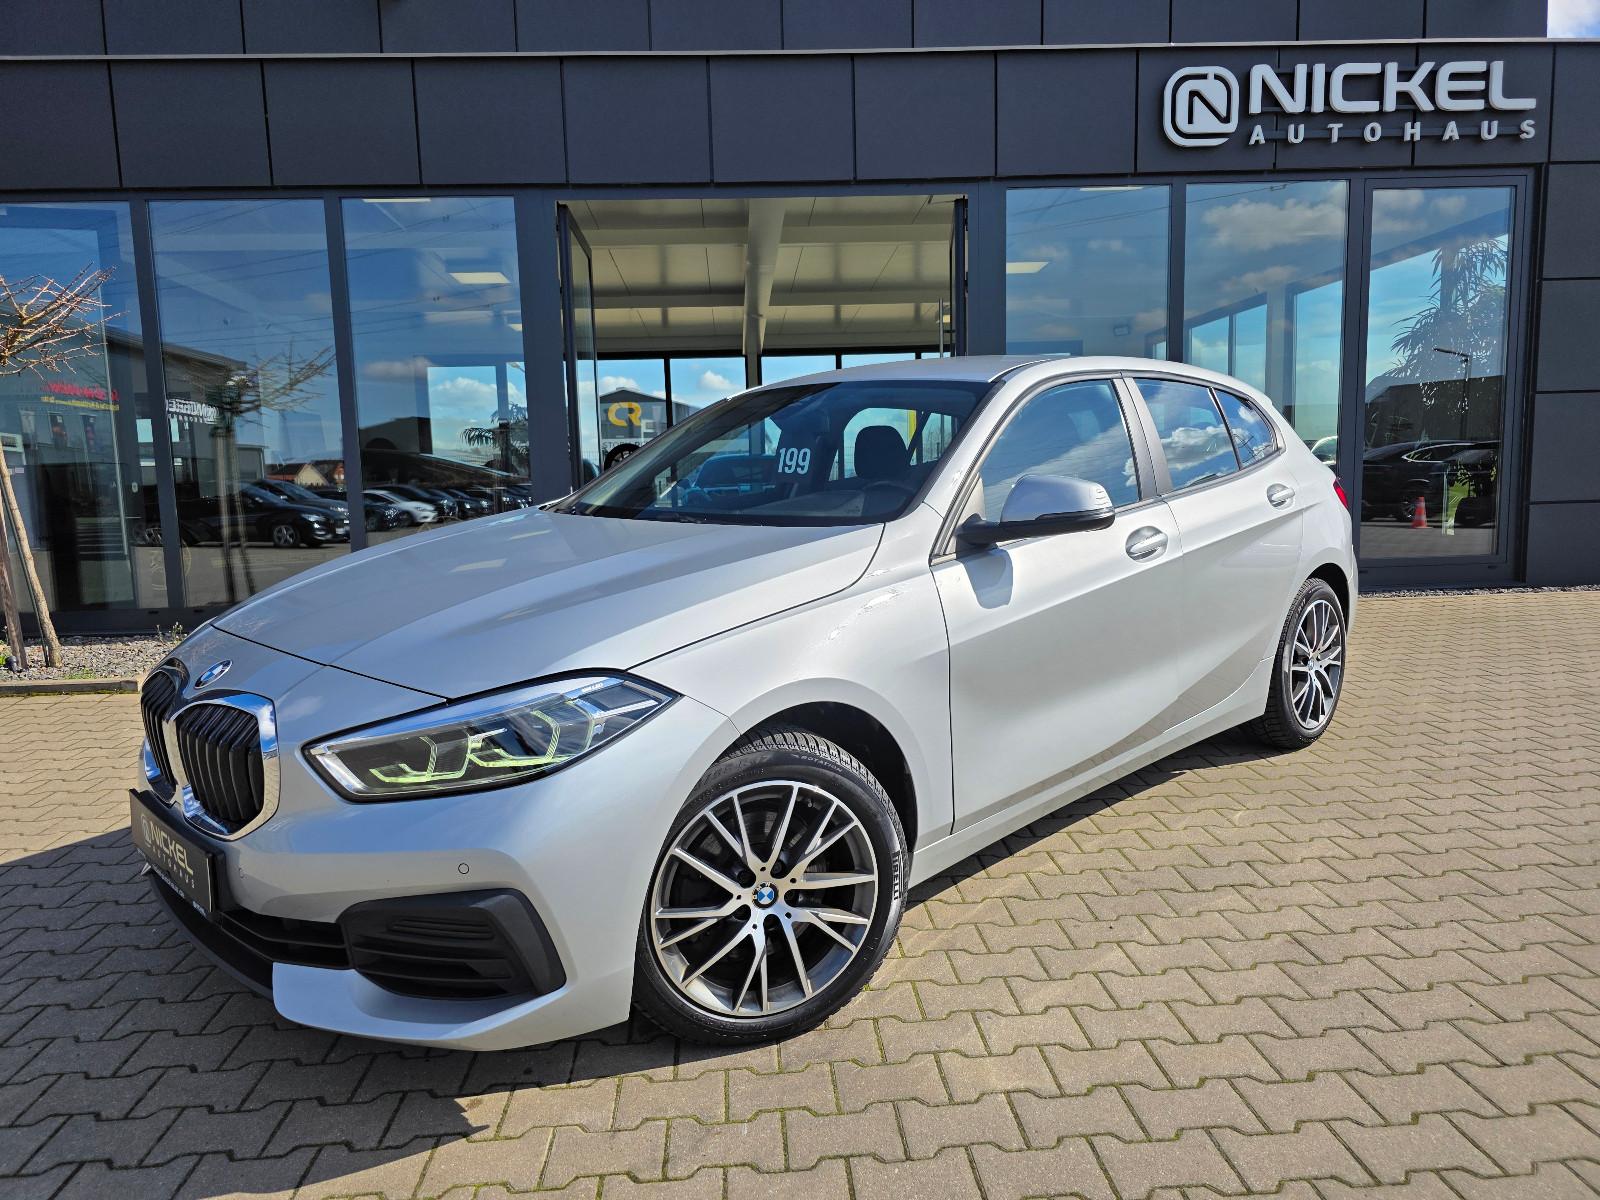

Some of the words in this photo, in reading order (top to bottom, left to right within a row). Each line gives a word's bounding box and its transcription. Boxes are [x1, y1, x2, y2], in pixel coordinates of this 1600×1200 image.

[1249, 60, 1537, 114] NICKEL
[1249, 119, 1536, 146] AUTOHAUS
[608, 401, 641, 427] CR
[778, 447, 811, 475] 199
[150, 820, 194, 875] NICKEL
